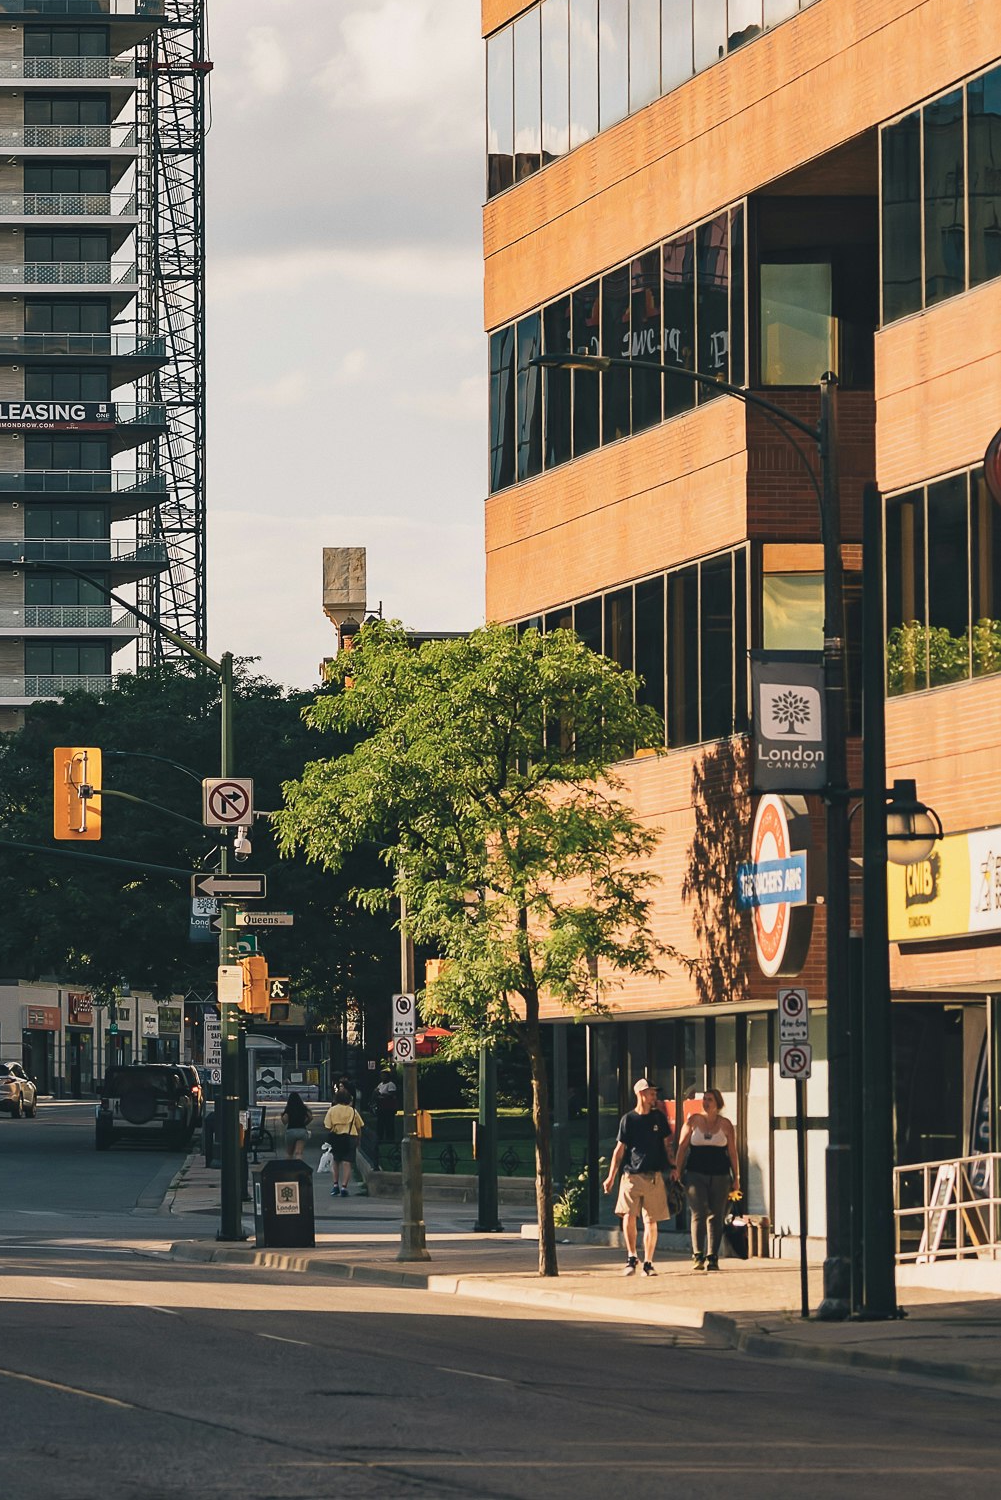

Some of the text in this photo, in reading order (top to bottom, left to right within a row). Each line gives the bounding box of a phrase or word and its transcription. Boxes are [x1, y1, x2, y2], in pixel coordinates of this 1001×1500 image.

[758, 744, 824, 761] London
[906, 860, 934, 898] CNIB
[190, 917, 210, 926] Lond
[244, 915, 279, 925] Queens
